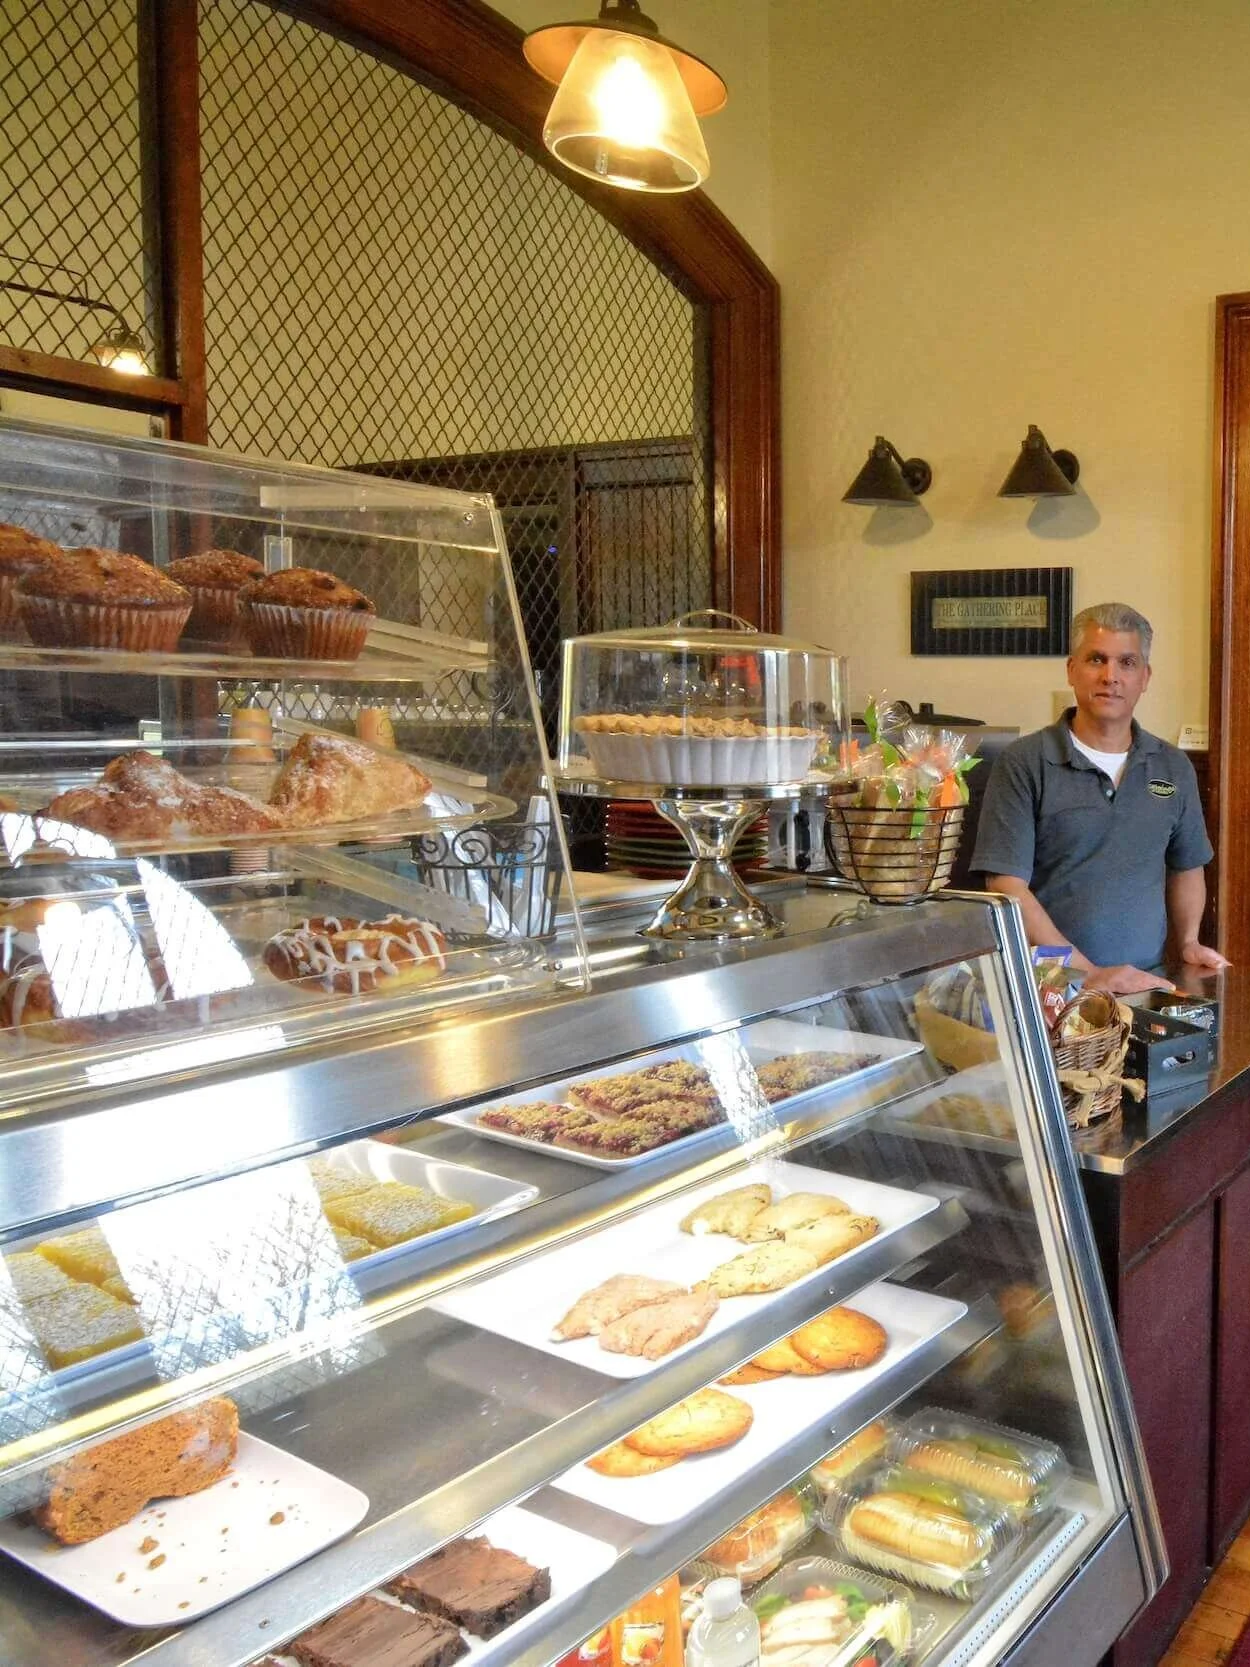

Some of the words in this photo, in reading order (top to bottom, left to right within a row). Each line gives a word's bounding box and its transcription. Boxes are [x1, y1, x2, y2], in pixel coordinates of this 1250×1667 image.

[938, 602, 956, 617] THE
[957, 600, 1012, 617] GATHERING
[1014, 599, 1046, 617] PLACE
